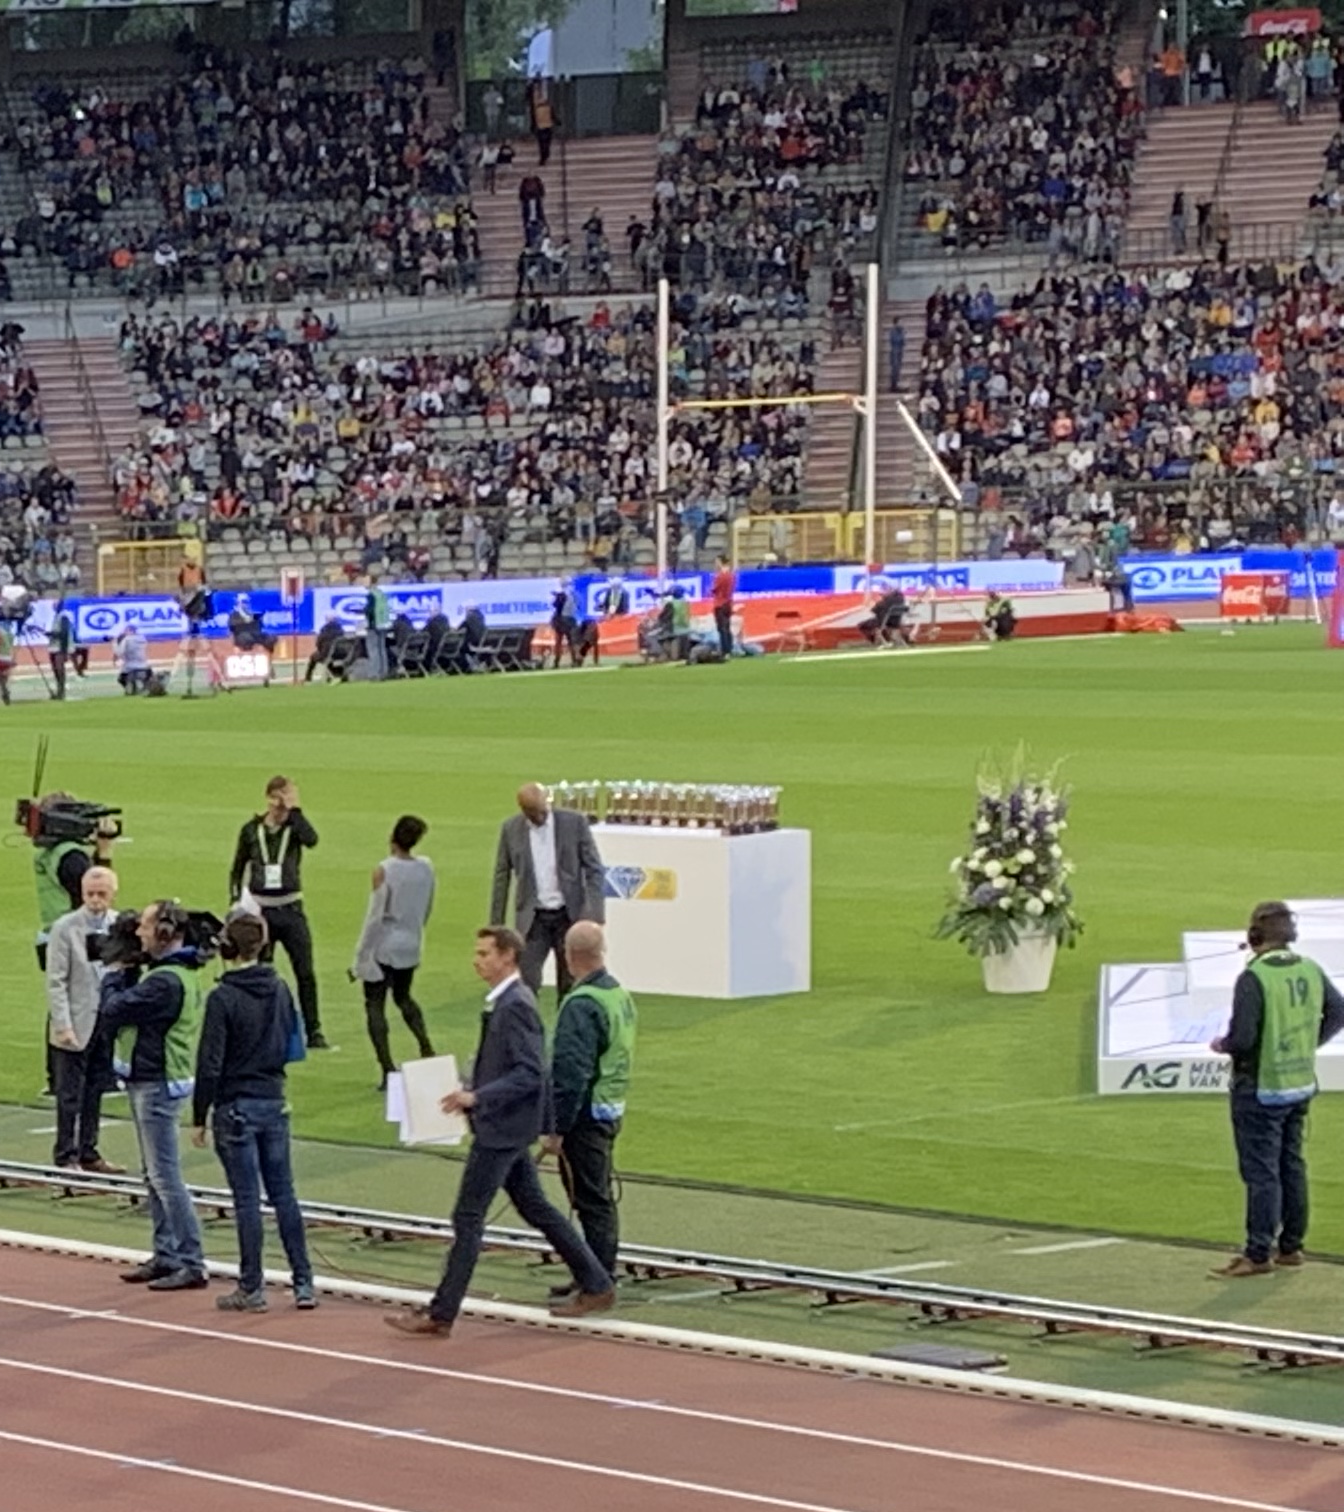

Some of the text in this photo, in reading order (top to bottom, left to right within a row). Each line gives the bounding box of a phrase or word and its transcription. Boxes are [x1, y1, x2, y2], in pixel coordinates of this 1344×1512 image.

[124, 608, 182, 623] PLAN
[1285, 976, 1309, 1009] 19
[1121, 1060, 1233, 1090] AG MEM
[1189, 1075, 1222, 1089] VAN
